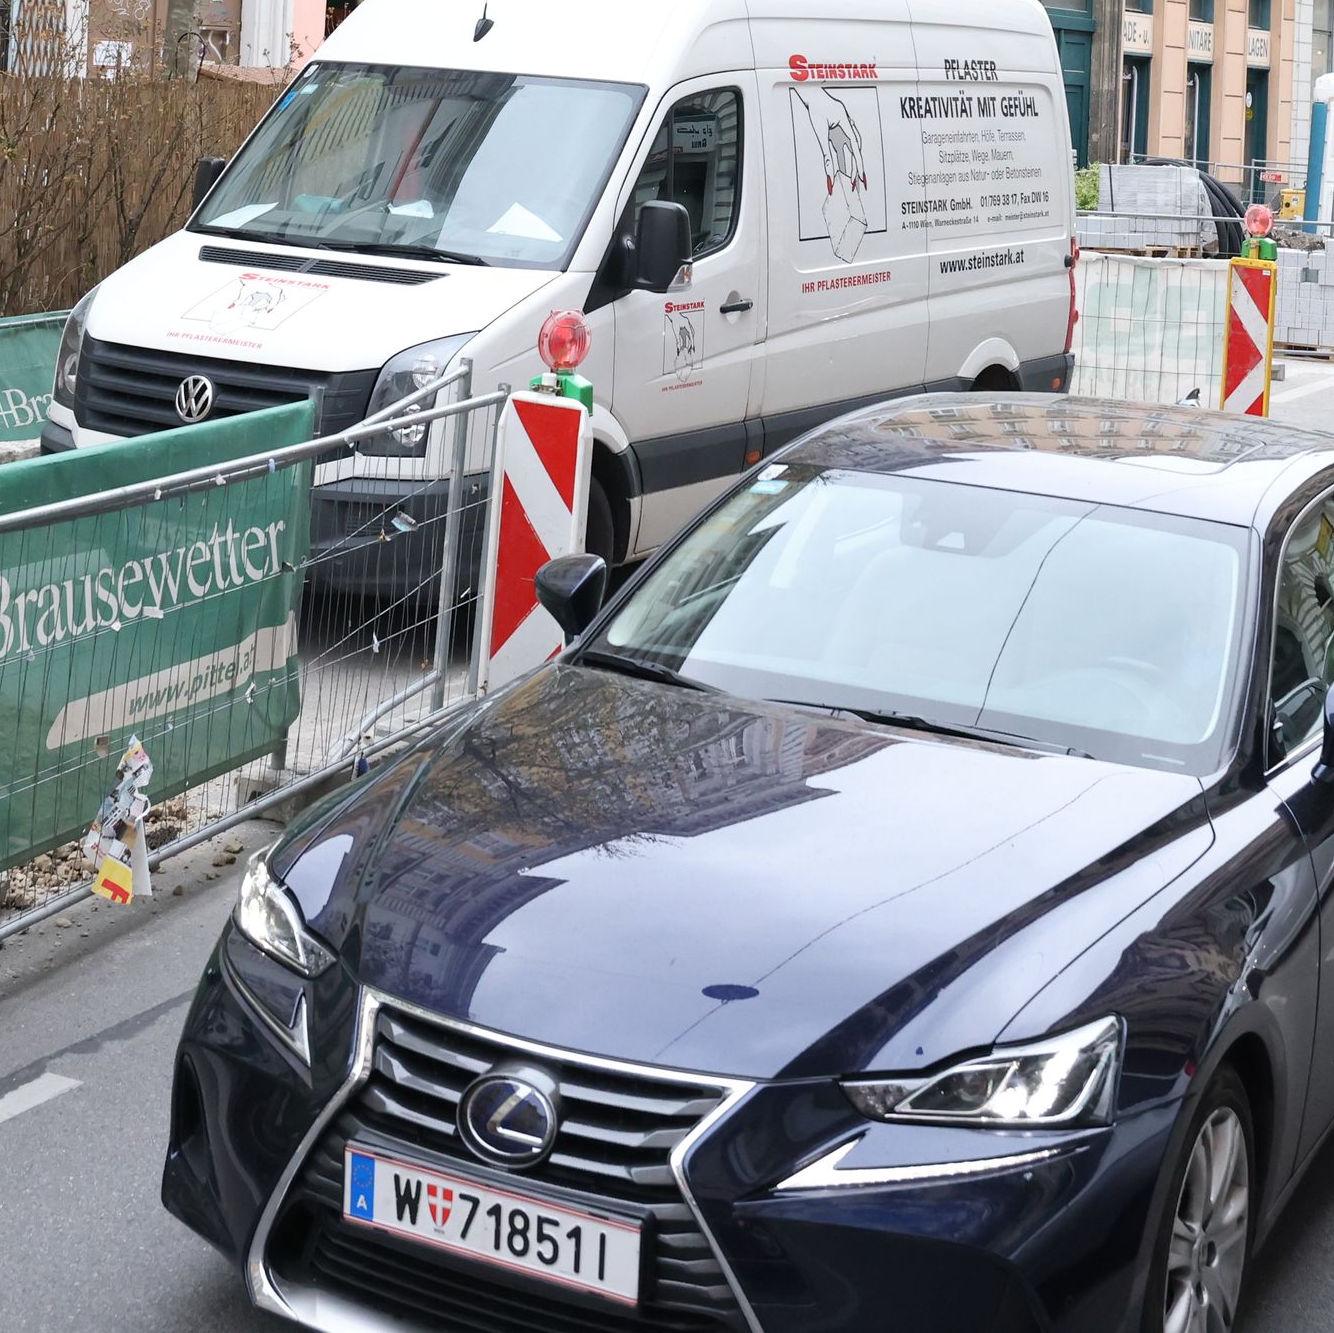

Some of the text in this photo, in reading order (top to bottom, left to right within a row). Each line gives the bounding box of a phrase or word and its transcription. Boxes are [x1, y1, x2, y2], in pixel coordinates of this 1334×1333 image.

[1248, 37, 1268, 59] LAGEN
[788, 54, 878, 82] STEINSTARK
[943, 58, 999, 81] PFLASTER
[899, 89, 1039, 119] KREATIVITÄT MIT GEFÜHL
[921, 128, 1027, 146] Garageneinfahrten, Höfe, Terrassen,
[938, 148, 1014, 165] Sitzplätze, Wege, Mauern,
[907, 165, 1042, 188] Stiegenanlagen aus Natur- oder Betonsteinen
[901, 199, 948, 214] STEINSTARK
[949, 197, 973, 211] GmbH.
[980, 194, 1000, 208] 01/769
[1002, 194, 1011, 205] 38
[1020, 193, 1030, 203] Fax
[1031, 192, 1042, 203] DW
[1042, 191, 1049, 202] 16
[919, 219, 933, 229] Wien,
[939, 249, 1025, 274] www.steinstark.at
[238, 272, 331, 290] STEINSTARK
[801, 271, 892, 294] IHR PFLASTERERMEISTER
[664, 301, 705, 314] STEINSTARK
[166, 331, 263, 350] IHR PFLASTERERMEISTER
[127, 644, 258, 716] www.pittel.at
[356, 1193, 368, 1210] A
